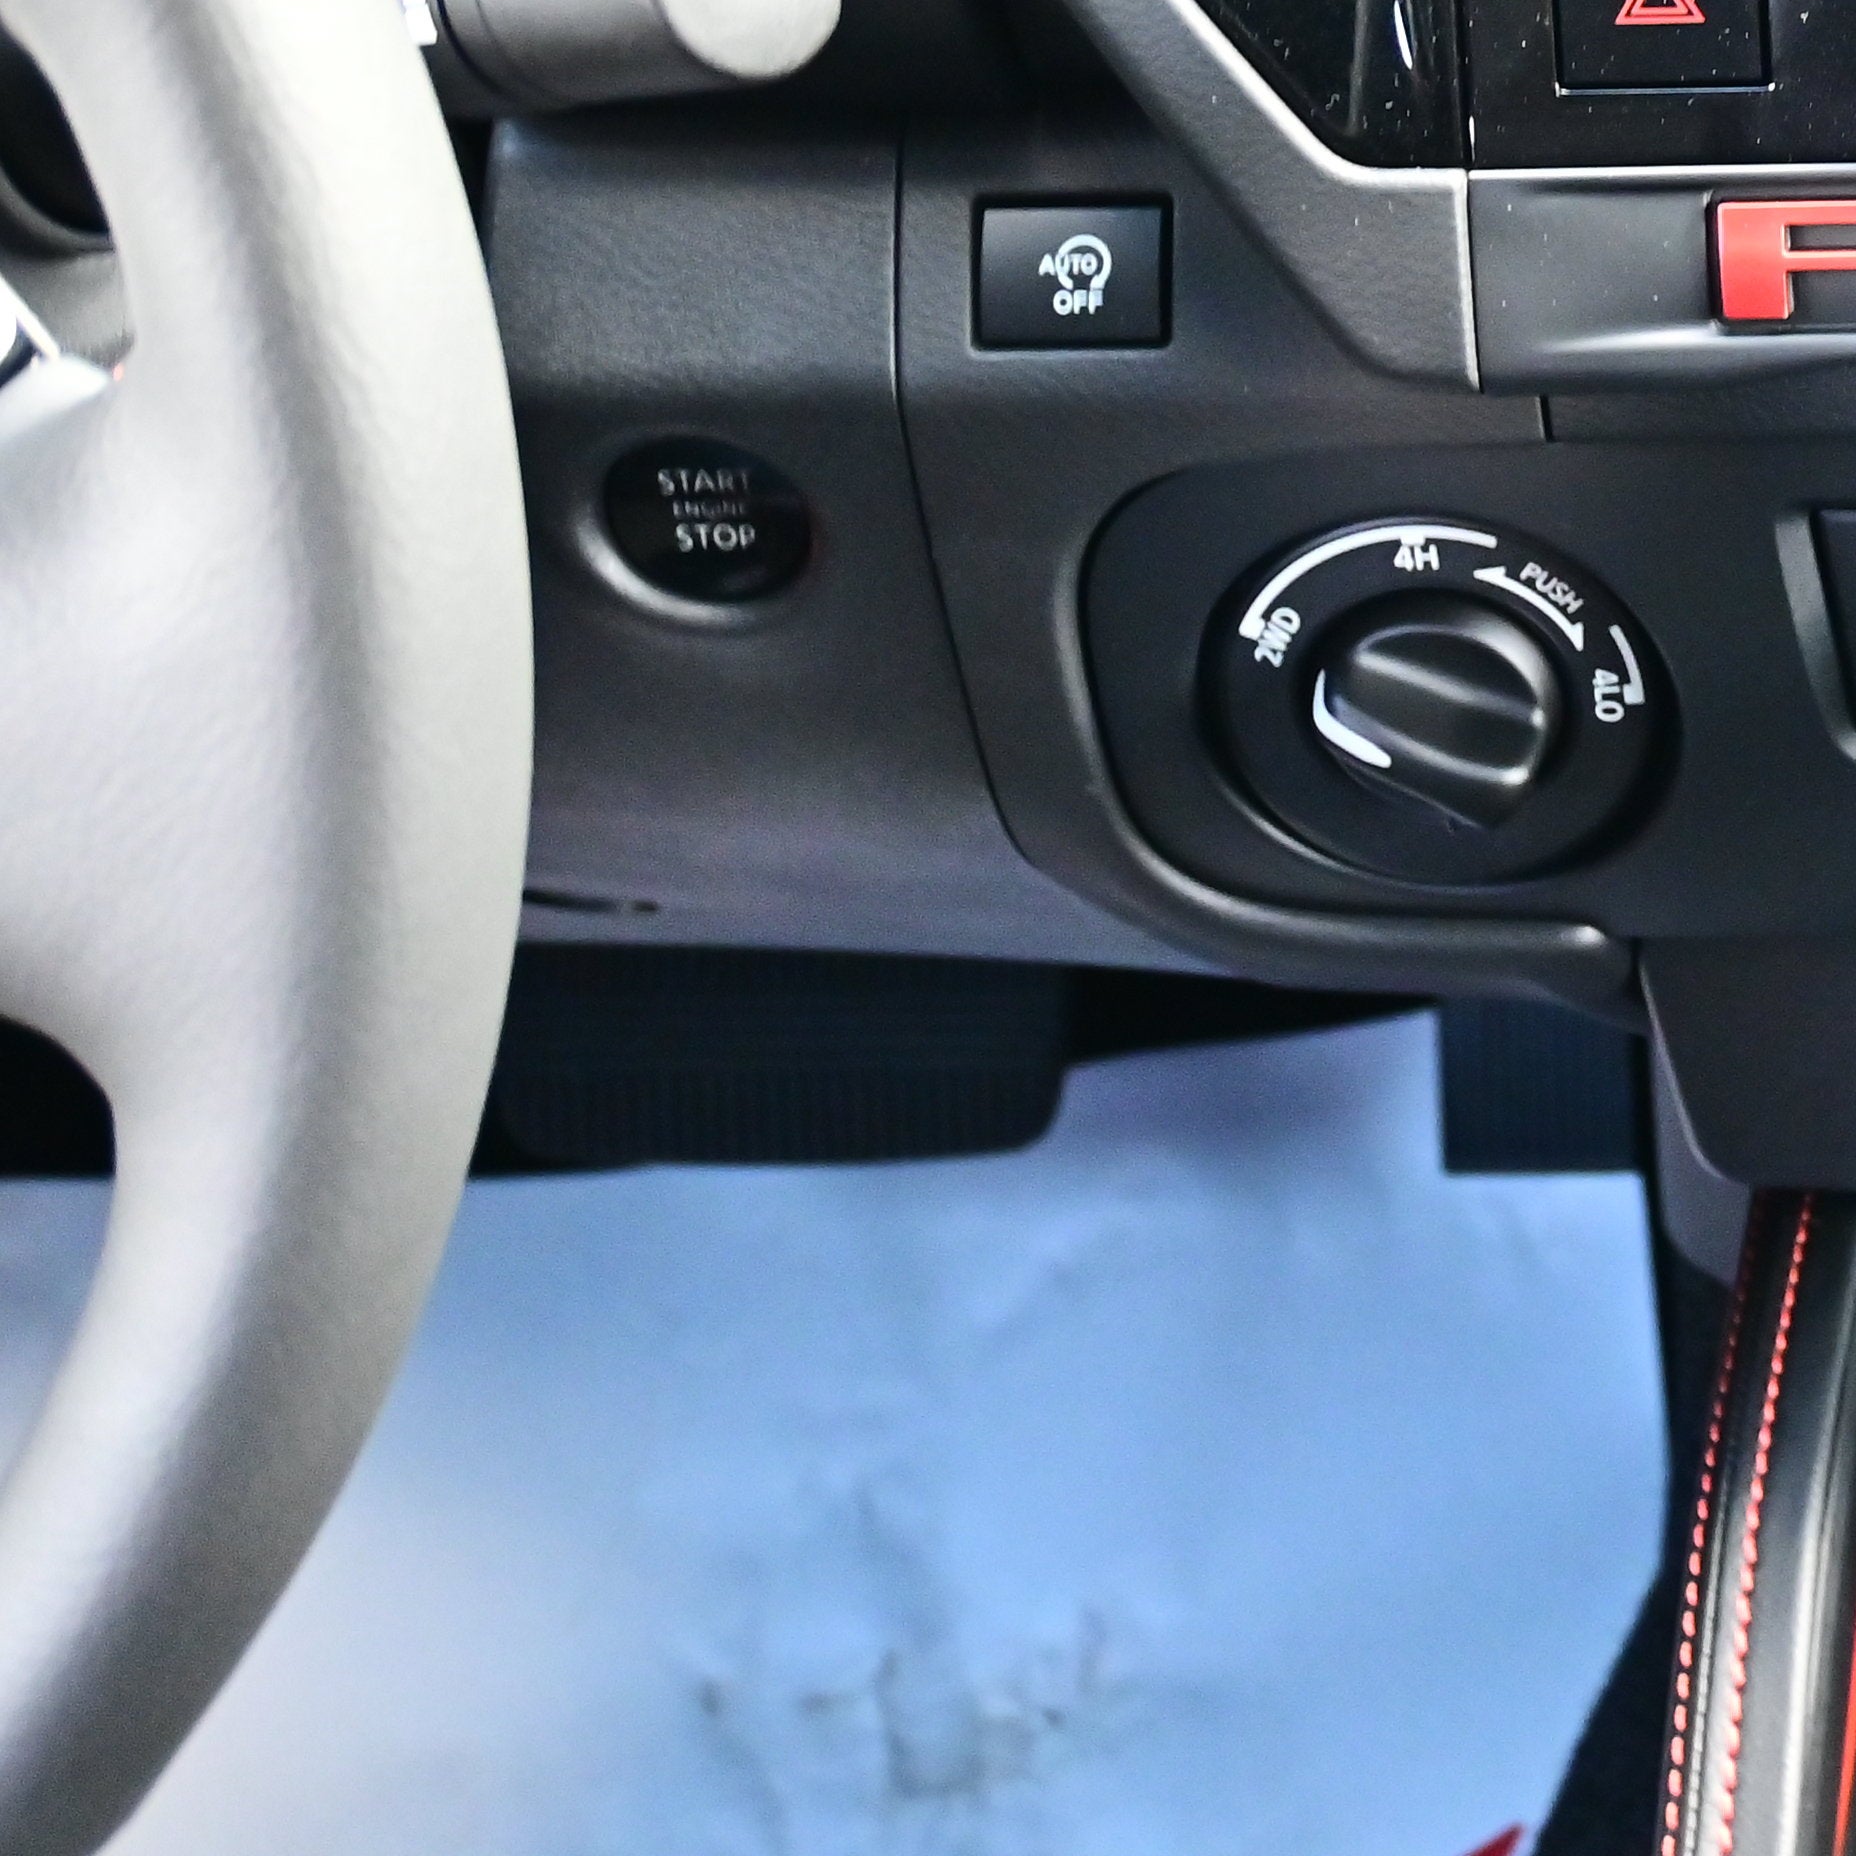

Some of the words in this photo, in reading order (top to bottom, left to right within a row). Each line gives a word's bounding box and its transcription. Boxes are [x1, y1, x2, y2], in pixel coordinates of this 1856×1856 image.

[1039, 252, 1098, 276] AUTO
[1053, 290, 1104, 315] OFF
[657, 469, 751, 494] START
[672, 499, 748, 519] ENGINE
[676, 524, 754, 550] STOP
[1393, 544, 1440, 572] 4H
[1519, 561, 1584, 615] PUSH
[1253, 606, 1301, 668] 2WD
[1592, 668, 1625, 723] 4LO
